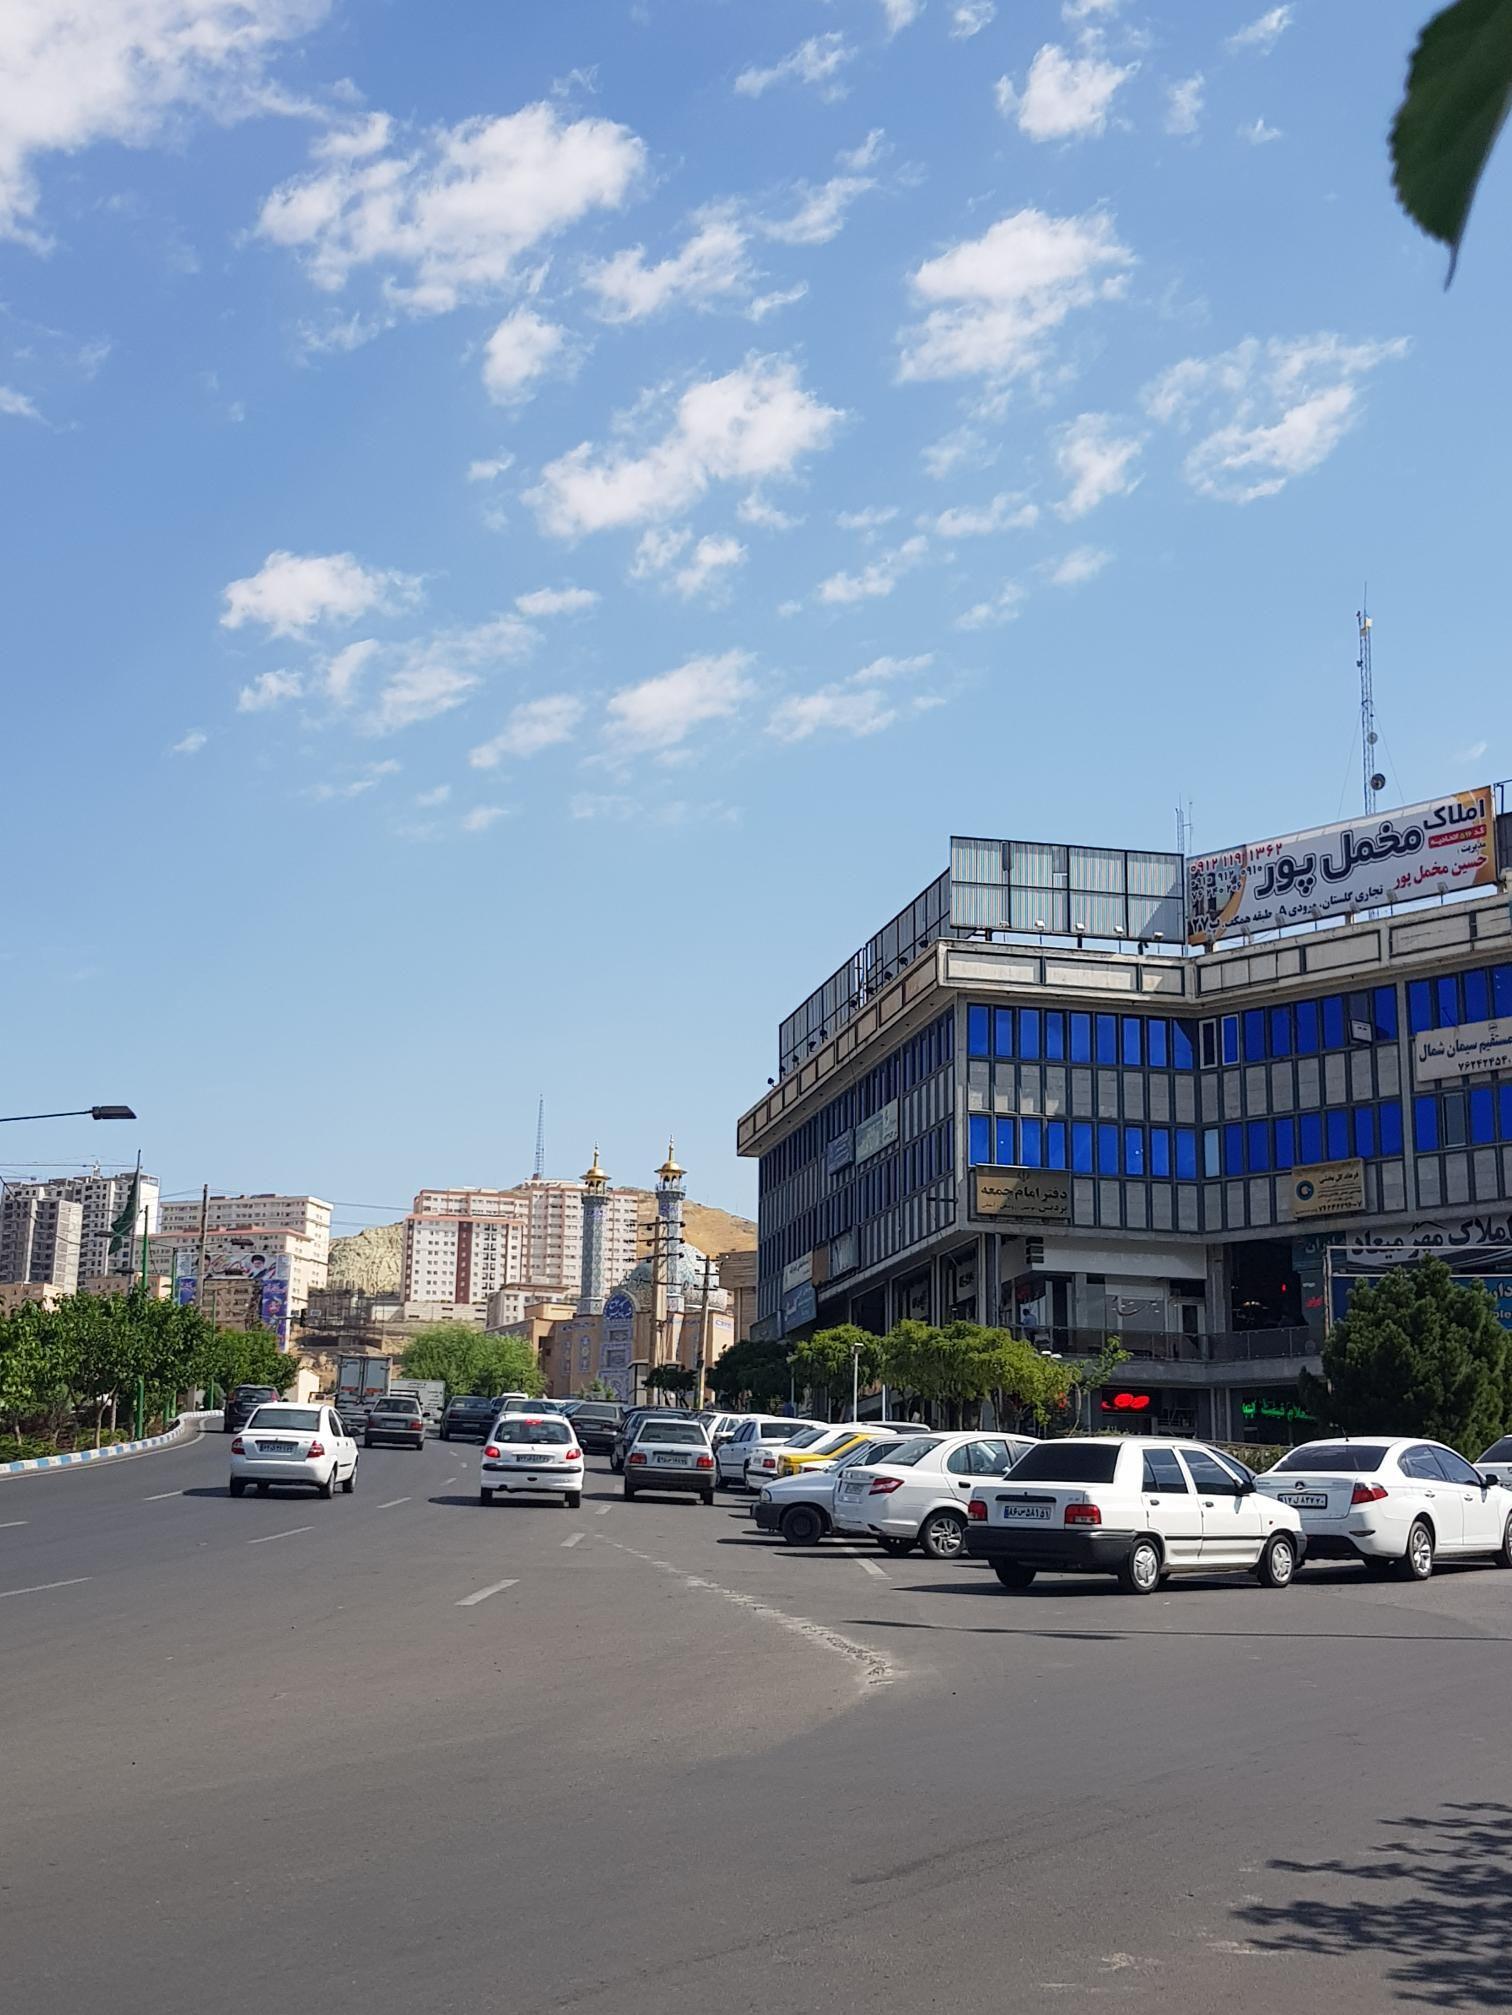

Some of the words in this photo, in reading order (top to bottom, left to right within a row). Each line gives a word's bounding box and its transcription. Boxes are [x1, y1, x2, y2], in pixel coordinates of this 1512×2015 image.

[1423, 799, 1485, 829] املاک
[1321, 822, 1424, 883] مخمل
[1413, 861, 1448, 884] مخمل
[1451, 856, 1487, 876] حسین
[1254, 853, 1317, 901] پور
[1354, 884, 1383, 902] تجاری
[1419, 1041, 1445, 1063] شمال
[1446, 1039, 1477, 1058] سیمان
[981, 1186, 1013, 1200] جمعه
[1014, 1186, 1040, 1200] امام
[1040, 1186, 1067, 1202] دفتر
